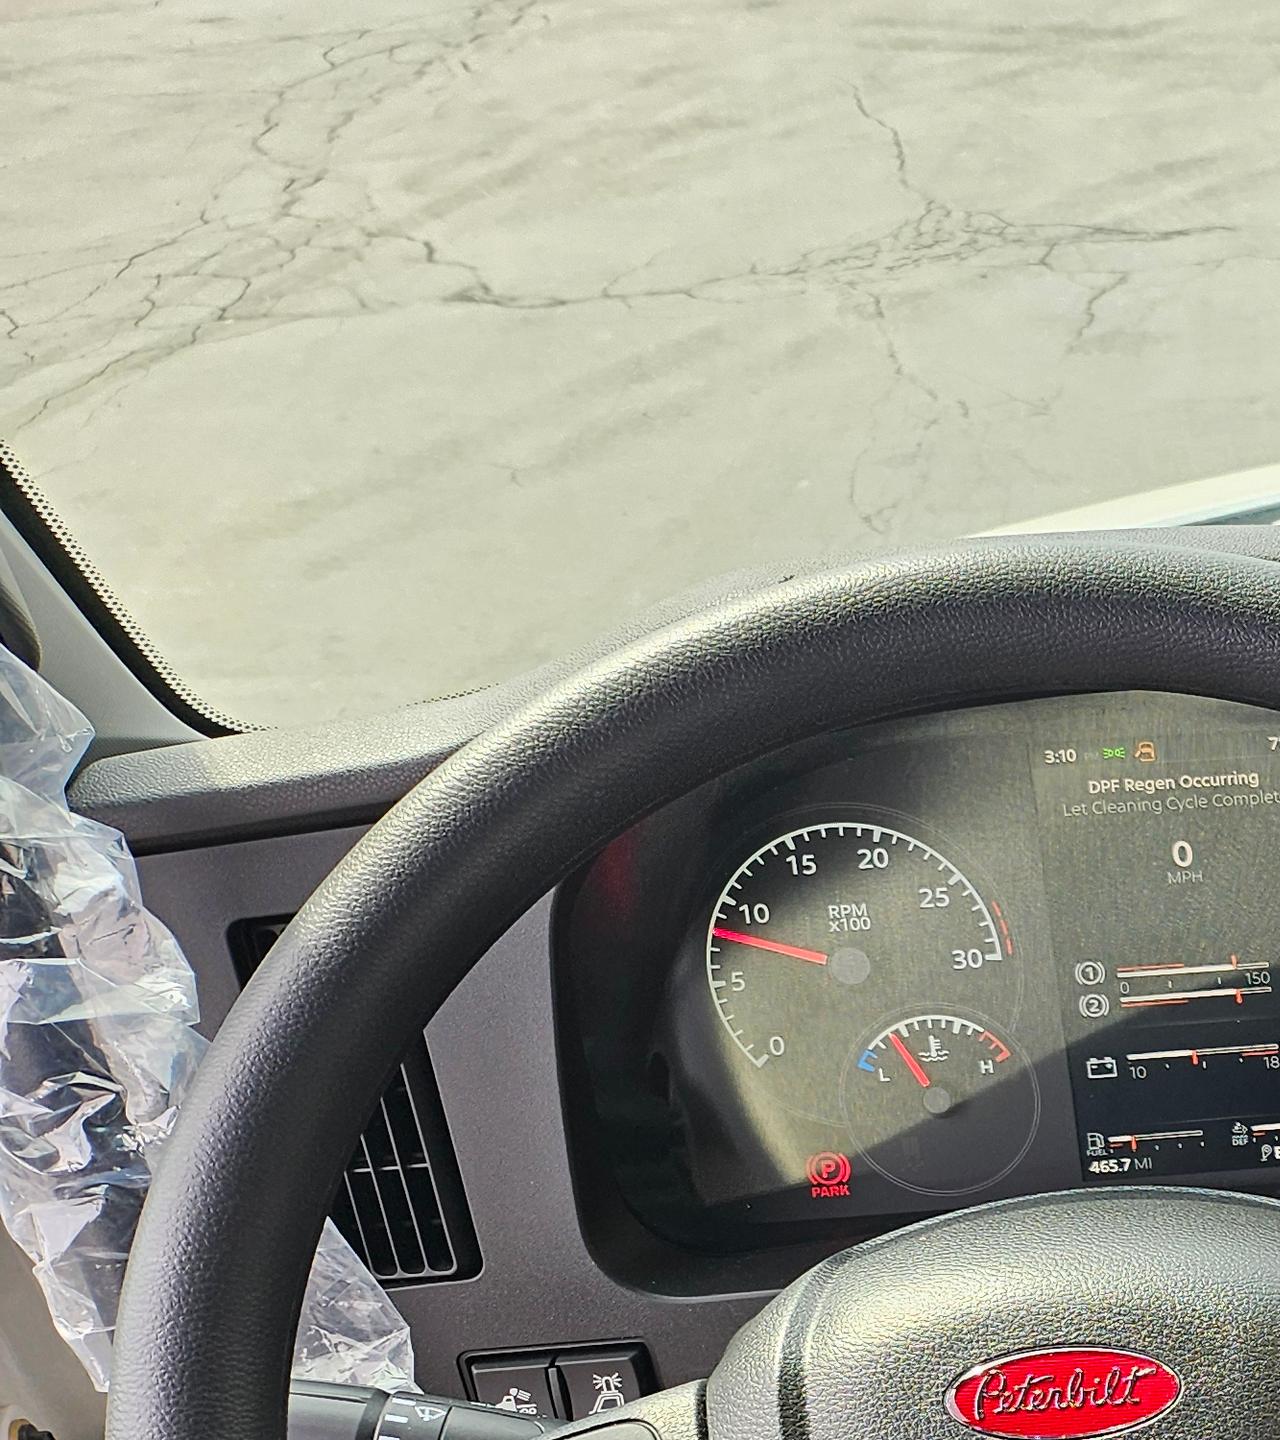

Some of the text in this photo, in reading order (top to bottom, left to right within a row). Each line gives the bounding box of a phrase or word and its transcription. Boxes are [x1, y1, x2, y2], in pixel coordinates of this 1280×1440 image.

[1043, 748, 1077, 764] 3:10
[1088, 771, 1260, 795] DPF Regen Occurring
[1063, 803, 1088, 817] Let
[1092, 798, 1163, 816] Cleaning
[1166, 795, 1209, 811] Cycle
[857, 847, 889, 871] 20
[1172, 841, 1194, 868] 0
[785, 854, 817, 876] 15
[1167, 870, 1204, 885] MPH
[919, 887, 950, 909] 25
[739, 903, 770, 925] 10
[828, 903, 868, 919] RPM
[952, 949, 983, 970] 30
[731, 972, 746, 992] 5
[1245, 971, 1271, 985] 150
[1119, 981, 1130, 995] 0
[769, 1037, 785, 1056] 0
[980, 1060, 994, 1075] H
[1263, 1056, 1280, 1069] 18
[879, 1068, 890, 1082] L
[1129, 1066, 1147, 1079] 10
[1088, 1158, 1153, 1174] 465.7 MI
[811, 1184, 850, 1198] PARK
[975, 1366, 1156, 1420] Peterbilt
